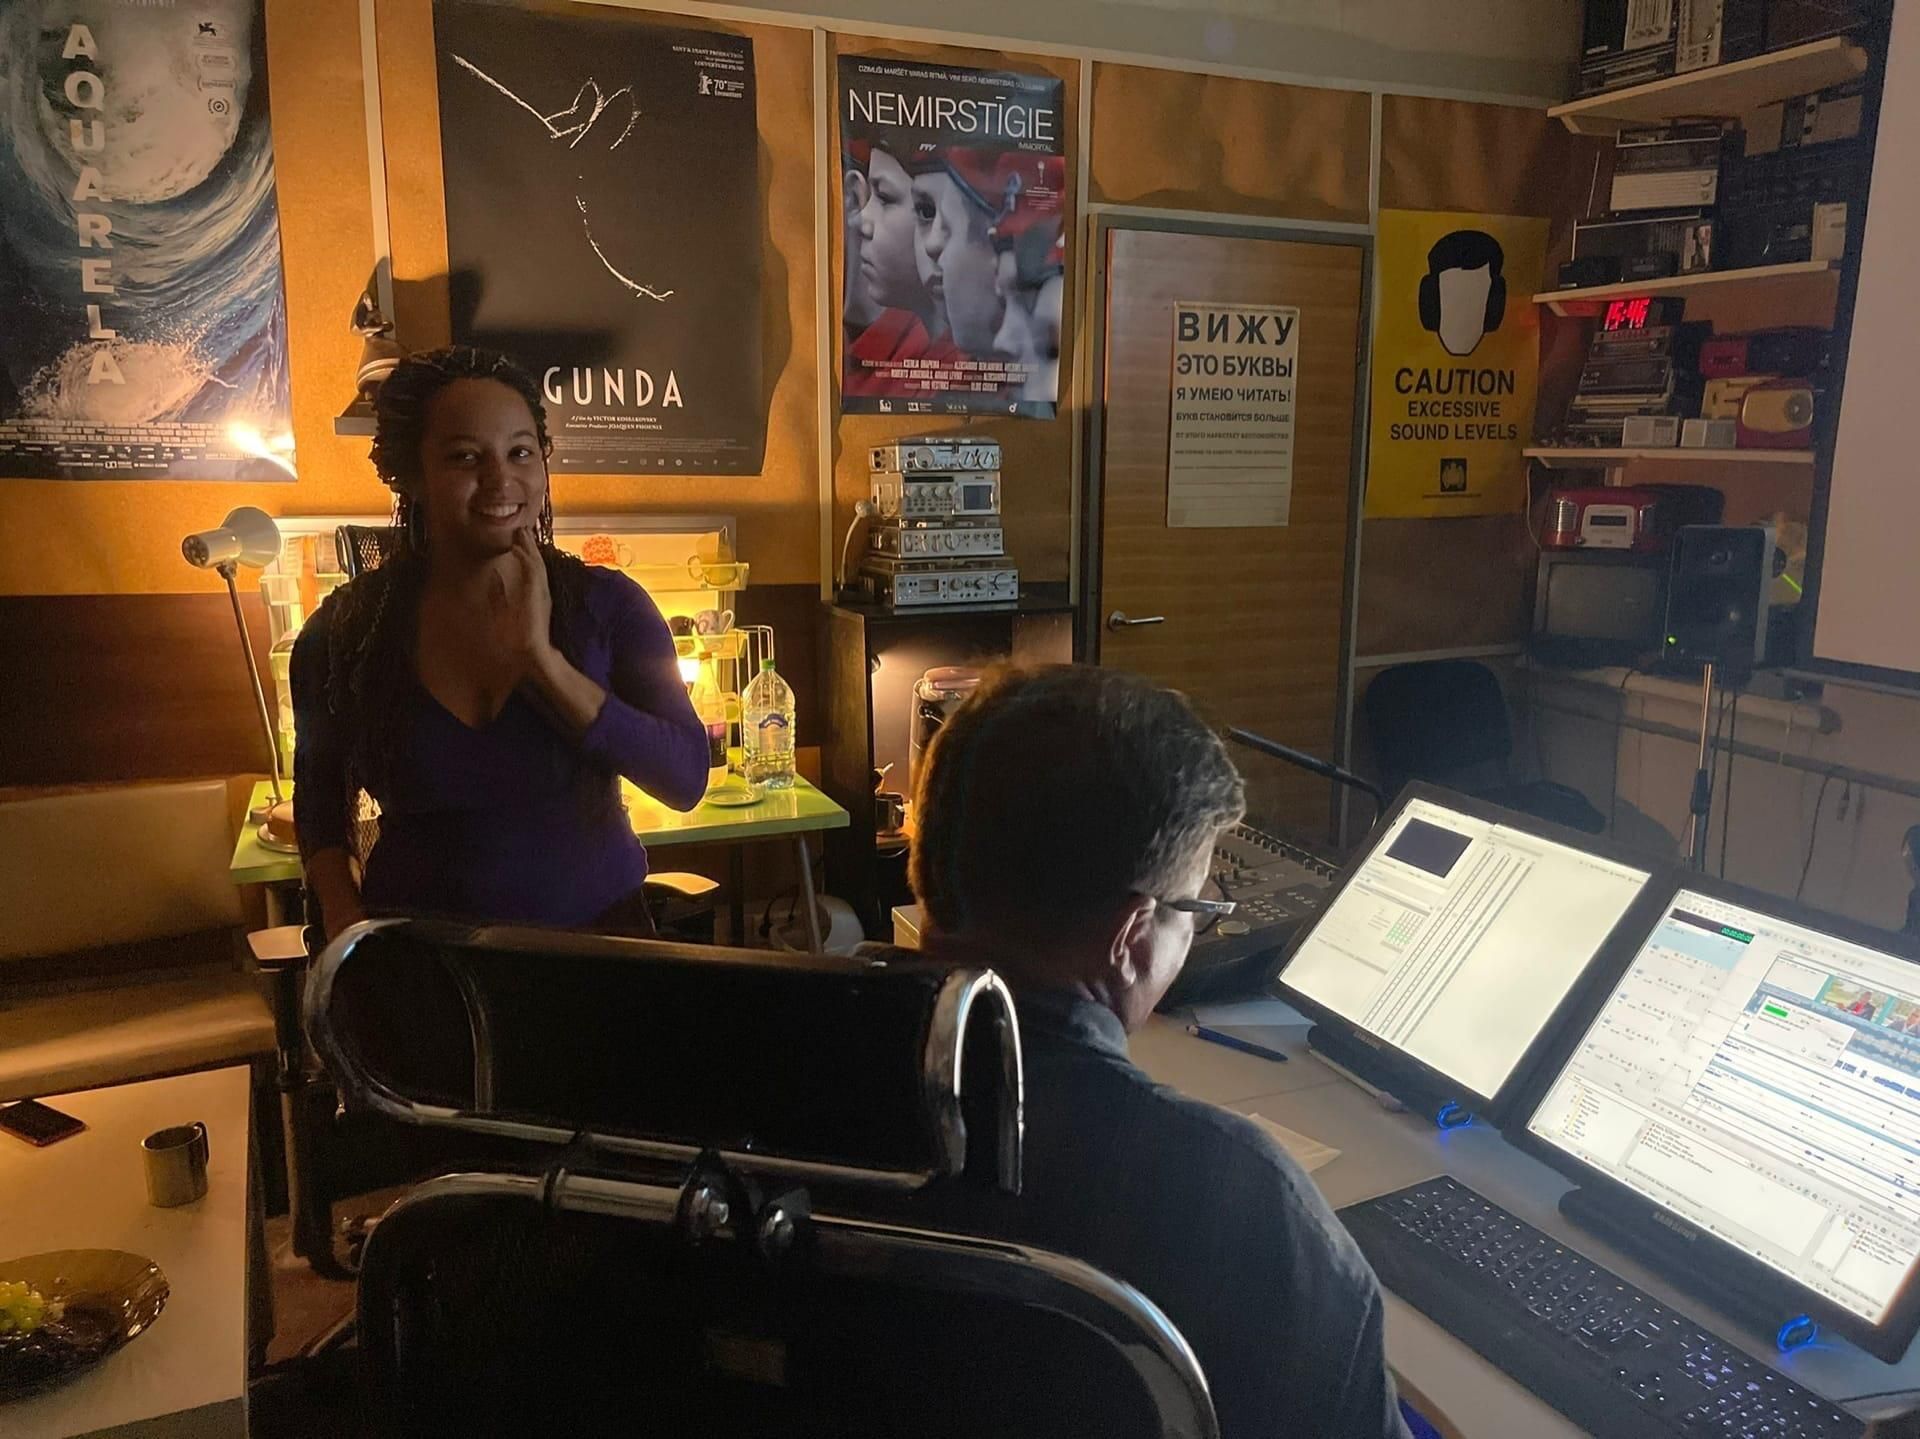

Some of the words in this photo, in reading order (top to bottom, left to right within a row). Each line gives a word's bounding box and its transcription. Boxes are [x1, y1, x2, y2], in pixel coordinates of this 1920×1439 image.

[849, 88, 1054, 141] NEMIRSTĪGIE
[1018, 142, 1054, 152] IMMORTAL
[62, 24, 126, 385] AQUARELA
[1178, 312, 1294, 346] ВИЖУ
[1177, 353, 1219, 376] ЭТО
[1223, 356, 1292, 378] БУКВЫ
[543, 366, 683, 408] GUNDA
[1176, 387, 1186, 400] Я
[1189, 387, 1233, 401] УМЕЮ
[1237, 389, 1291, 402] ЧИТАТЬ!
[1395, 368, 1515, 396] CAUTION
[1176, 412, 1198, 421] БУКВ
[1200, 412, 1252, 422] СТАНОВИТСЯ
[1254, 413, 1289, 422] БОЛЬШЕ
[1408, 401, 1500, 417] EXCESSIVE
[1390, 423, 1449, 440] SOUND
[1454, 423, 1517, 440] LEVELS
